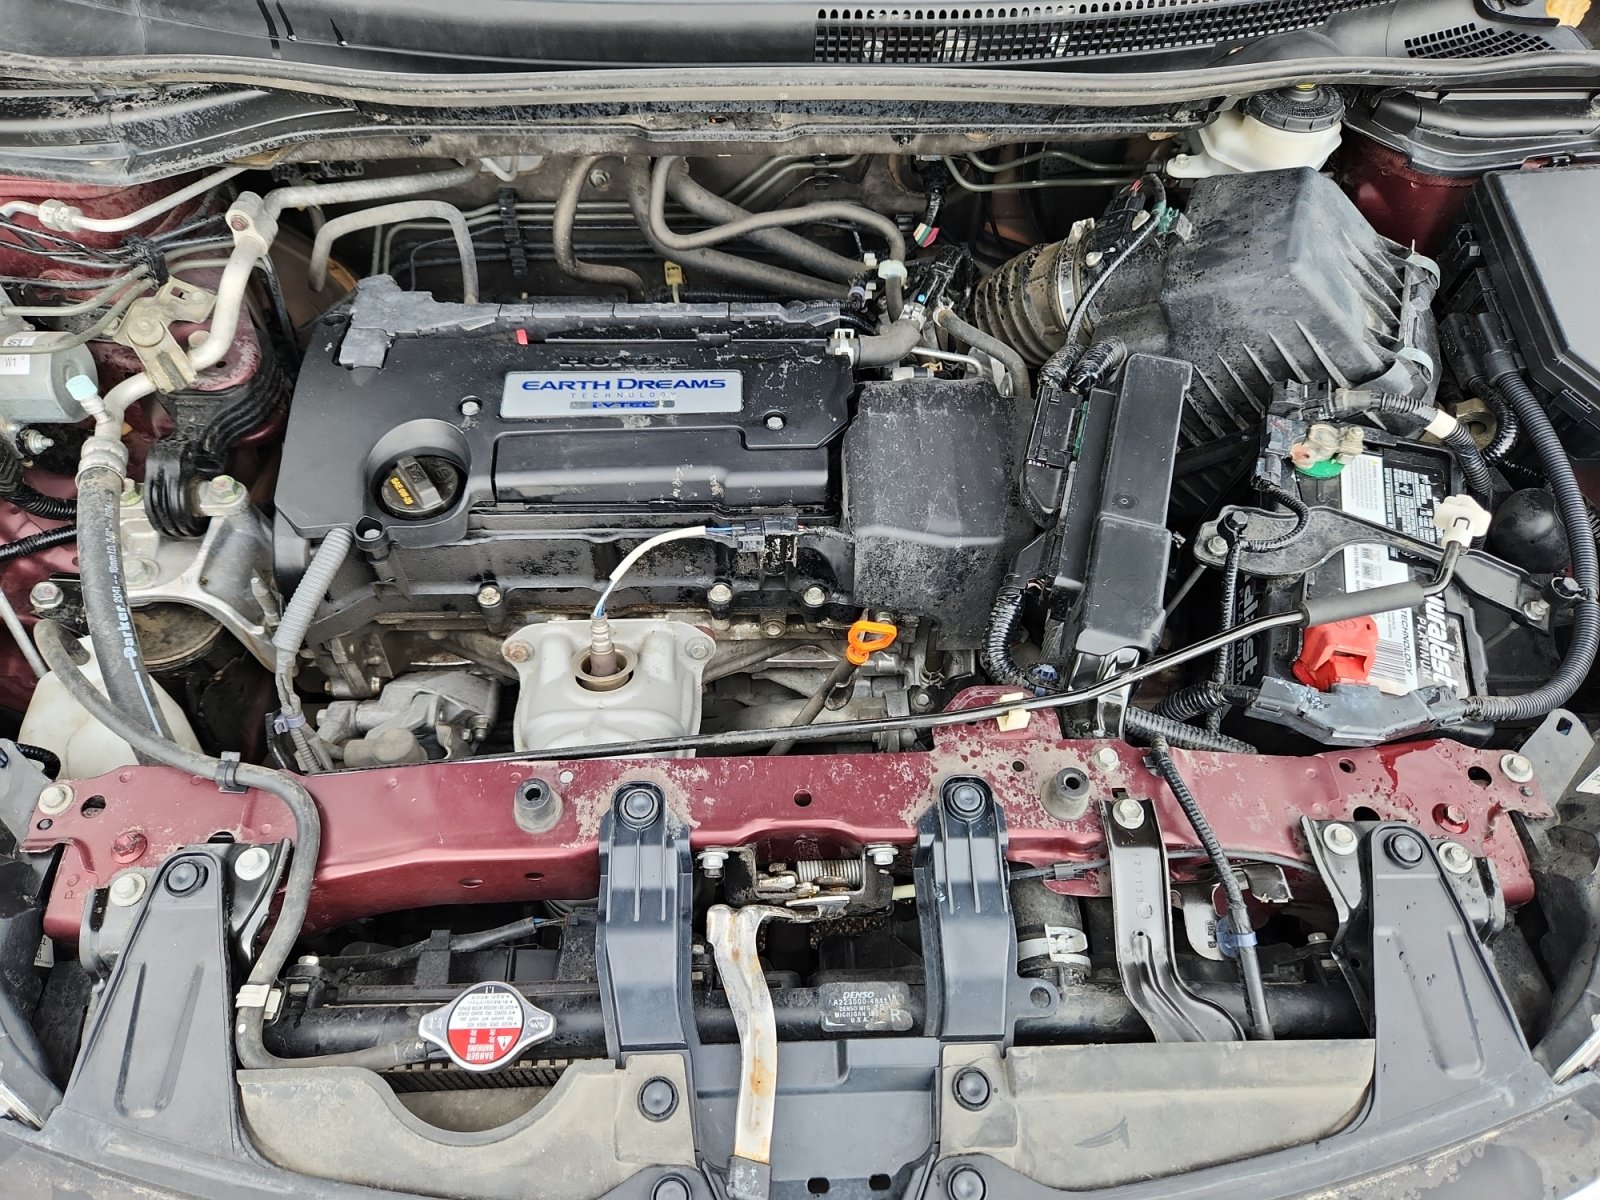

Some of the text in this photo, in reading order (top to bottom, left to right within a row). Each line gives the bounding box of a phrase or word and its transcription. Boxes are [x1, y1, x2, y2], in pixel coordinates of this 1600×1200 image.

[558, 354, 690, 368] HONDA
[521, 378, 727, 391] EARTH DREAMS
[390, 477, 403, 491] SAE
[117, 605, 138, 658] Parker
[1400, 609, 1413, 675] TECHNOLOGY
[1416, 616, 1431, 681] PLATINUM
[468, 1044, 495, 1052] WARNING
[466, 1052, 494, 1060] DANGER
